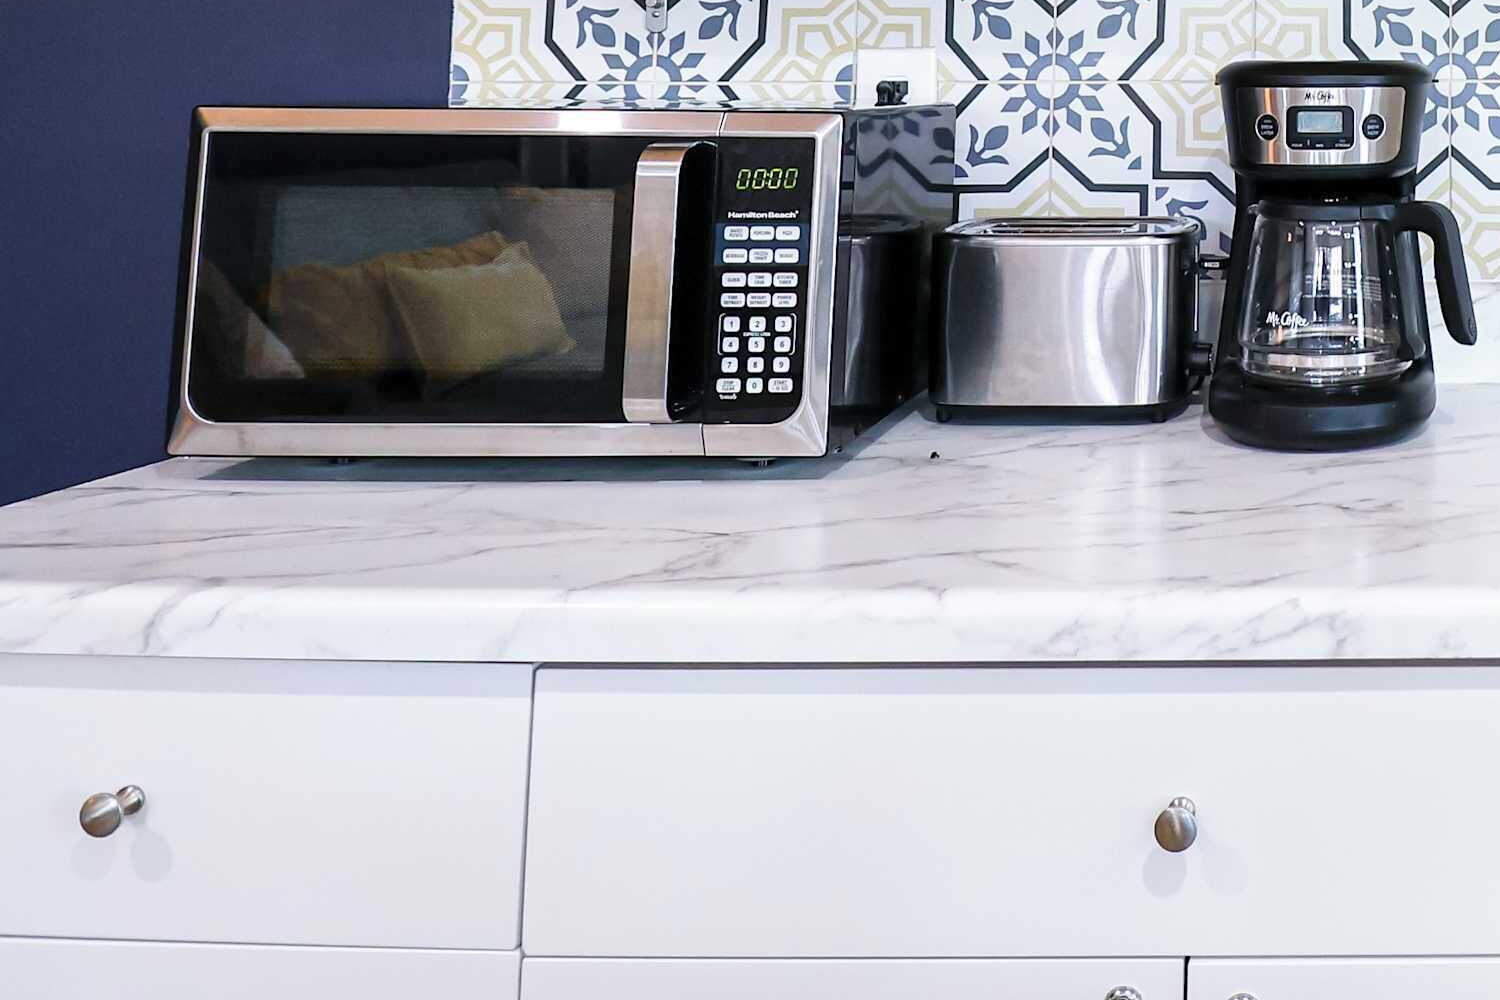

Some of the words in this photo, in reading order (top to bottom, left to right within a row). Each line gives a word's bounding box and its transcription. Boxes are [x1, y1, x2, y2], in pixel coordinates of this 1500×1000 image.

[736, 168, 798, 190] 00:00
[728, 211, 767, 219] Hamilton
[768, 211, 796, 219] Beach
[1281, 311, 1309, 330] Coffee
